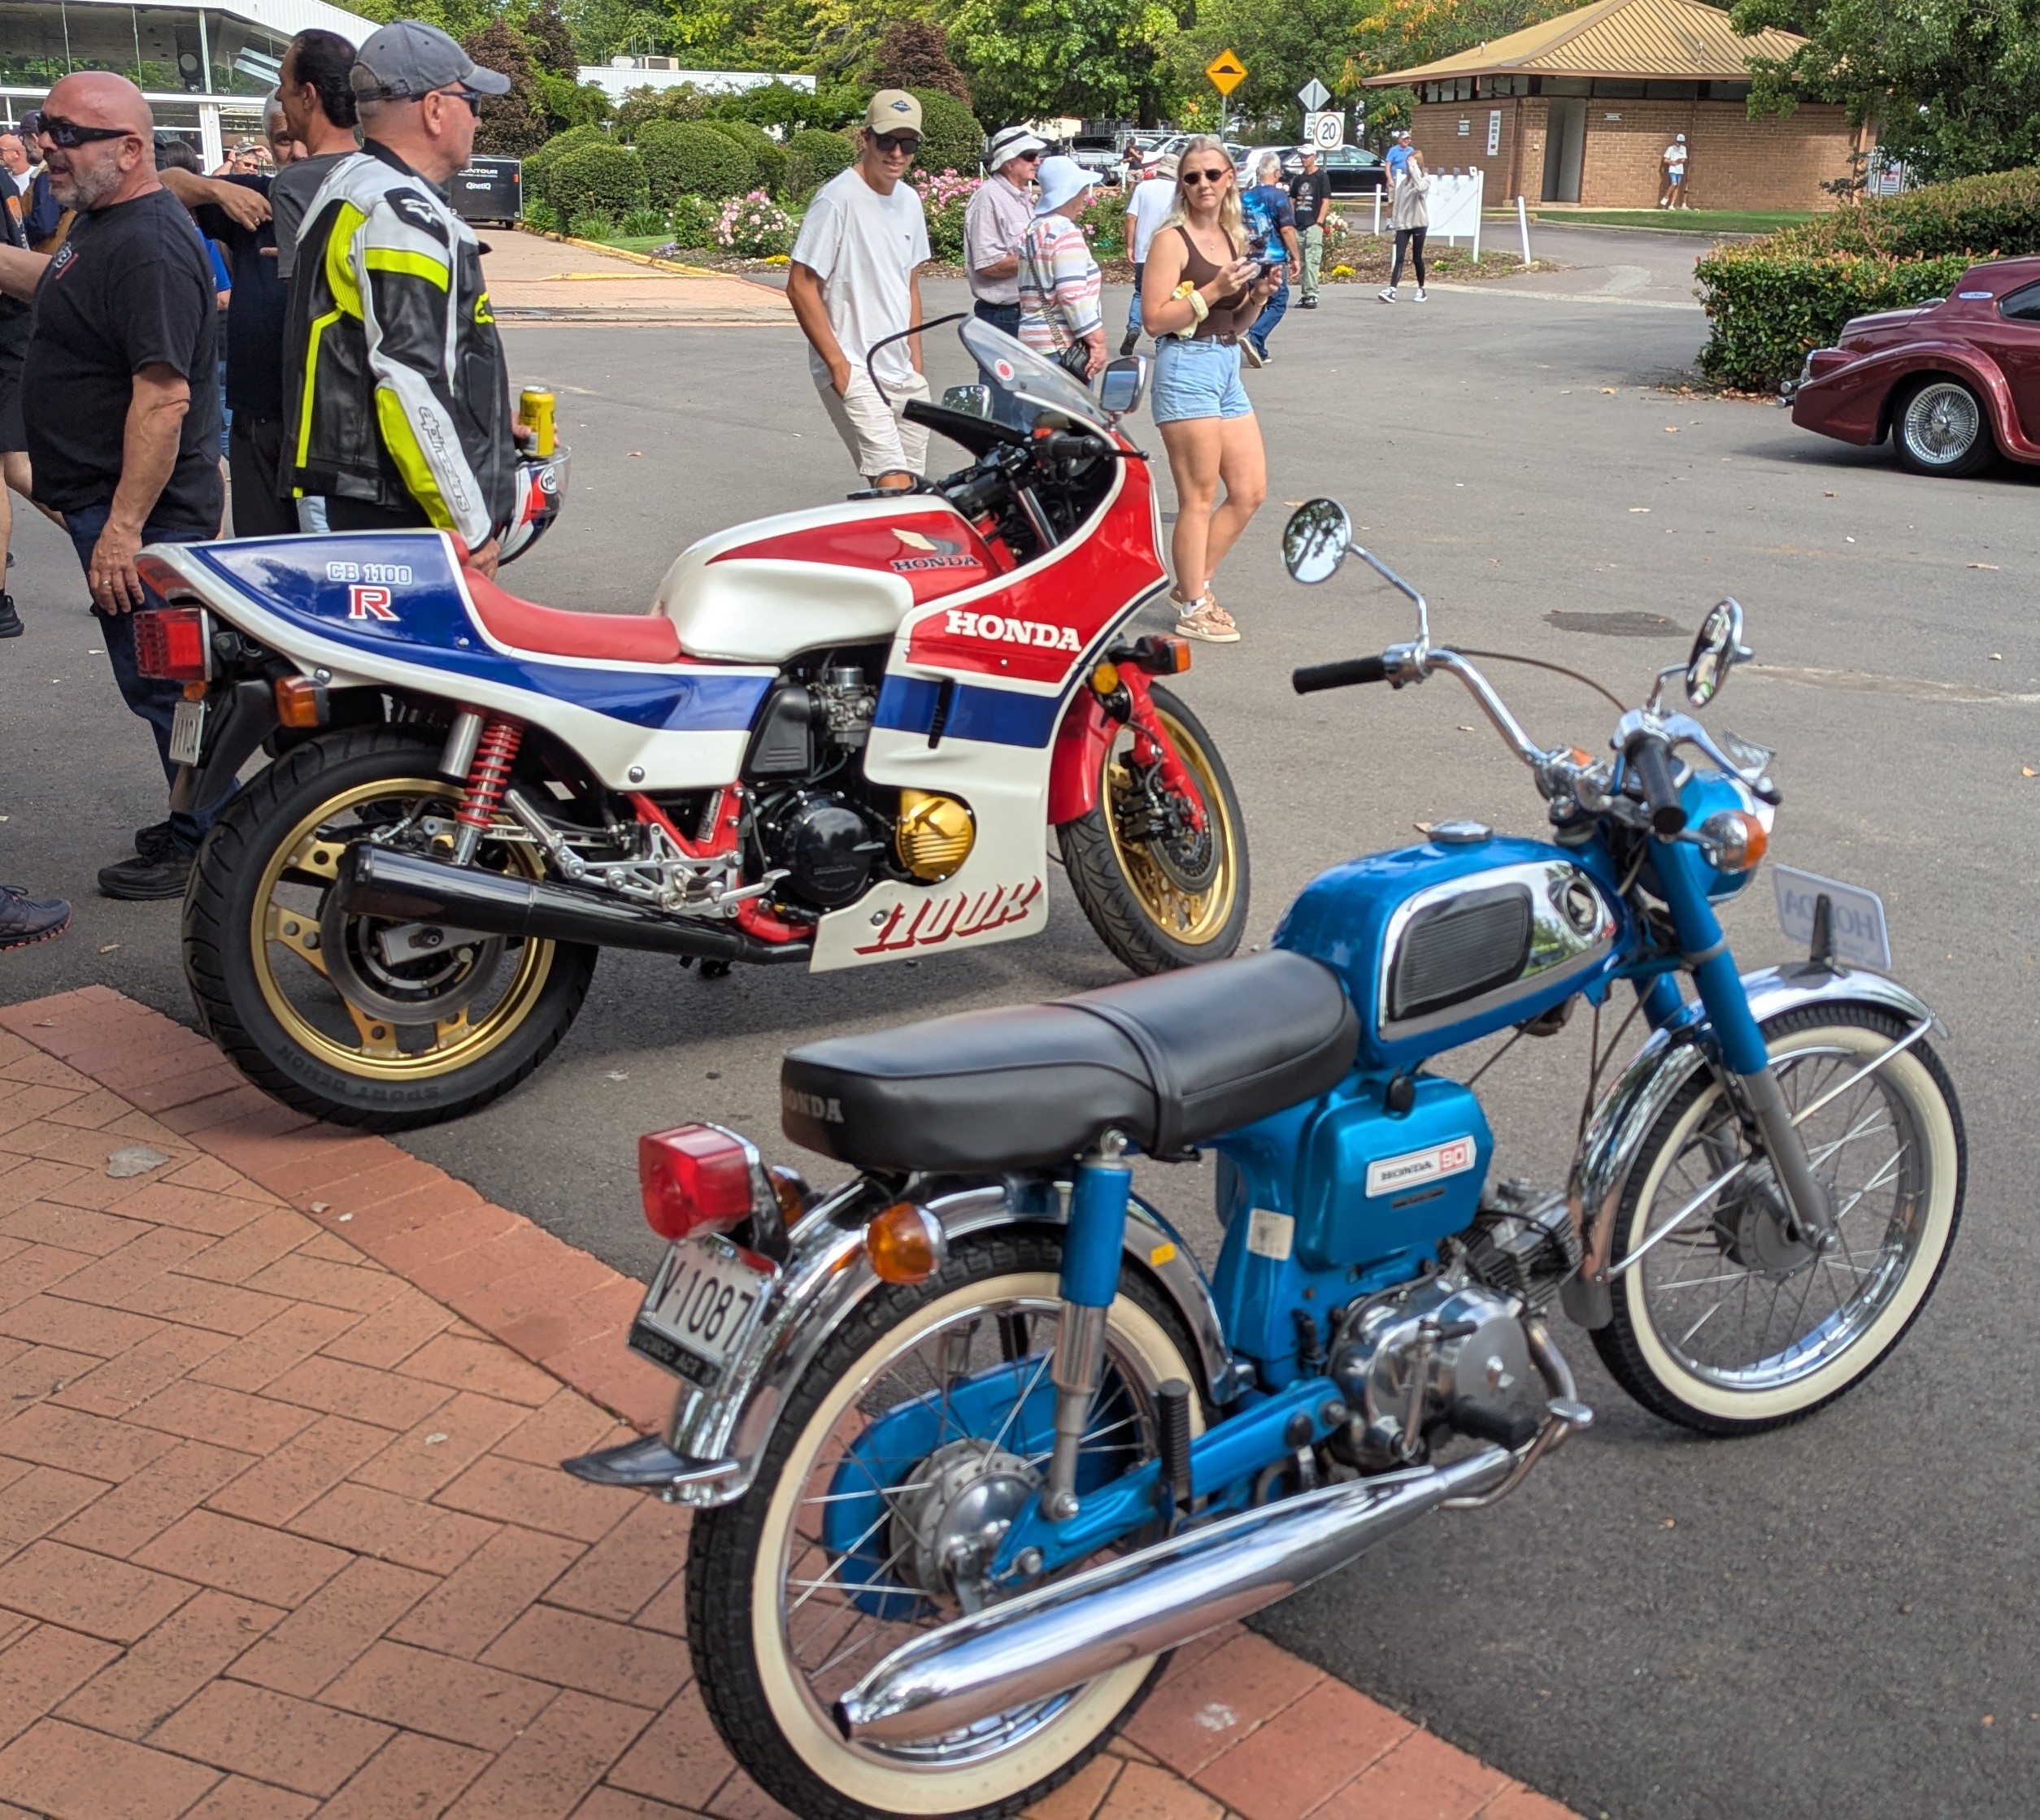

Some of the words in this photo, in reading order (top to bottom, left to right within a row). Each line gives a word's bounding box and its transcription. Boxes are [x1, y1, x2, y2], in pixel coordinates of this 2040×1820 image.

[1322, 122, 1336, 141] 20
[326, 561, 359, 582] CB
[363, 563, 412, 585] 1100
[892, 555, 983, 572] HONDA
[348, 584, 401, 621] R
[945, 610, 1082, 652] HONDA
[1380, 1160, 1434, 1182] HONDA
[1442, 1146, 1465, 1169] 90
